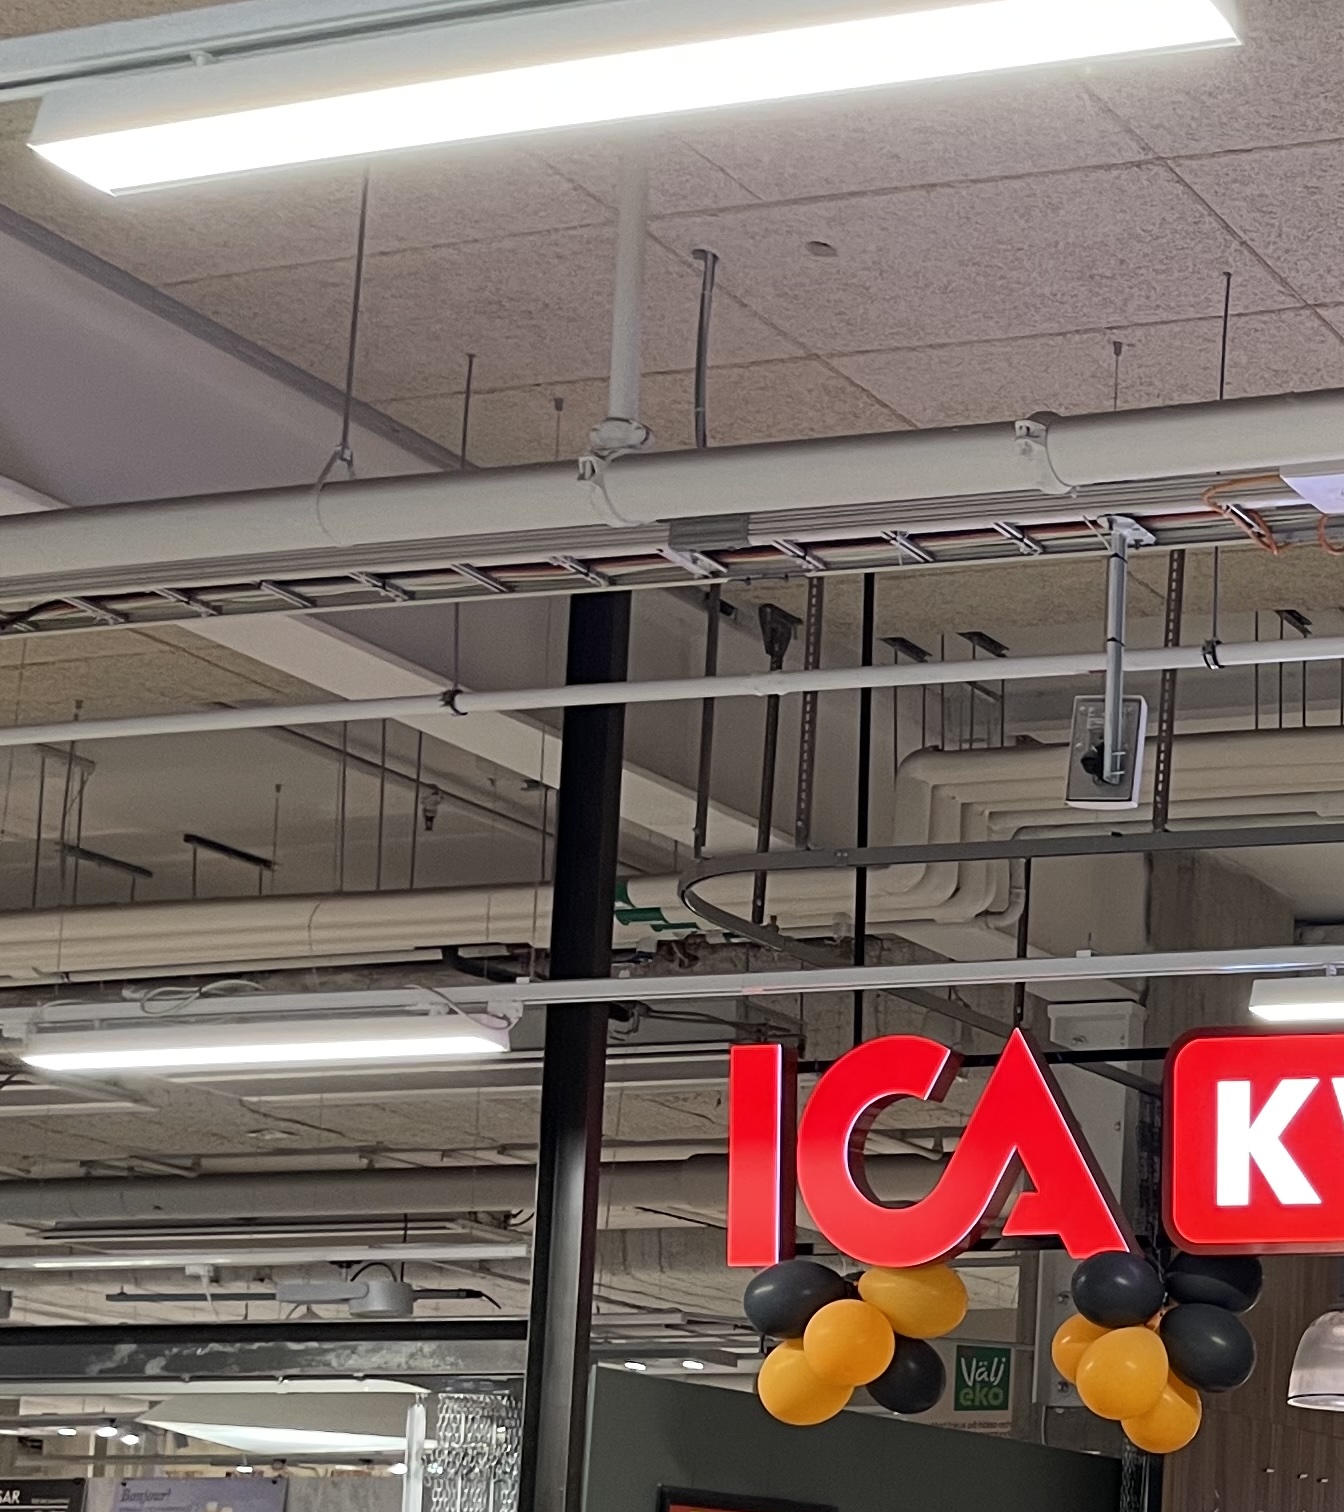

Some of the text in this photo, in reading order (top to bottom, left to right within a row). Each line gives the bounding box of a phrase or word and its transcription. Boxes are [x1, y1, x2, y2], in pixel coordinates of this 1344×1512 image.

[727, 1024, 1131, 1268] ICA
[960, 1357, 1006, 1386] Välj
[959, 1384, 1004, 1406] eko
